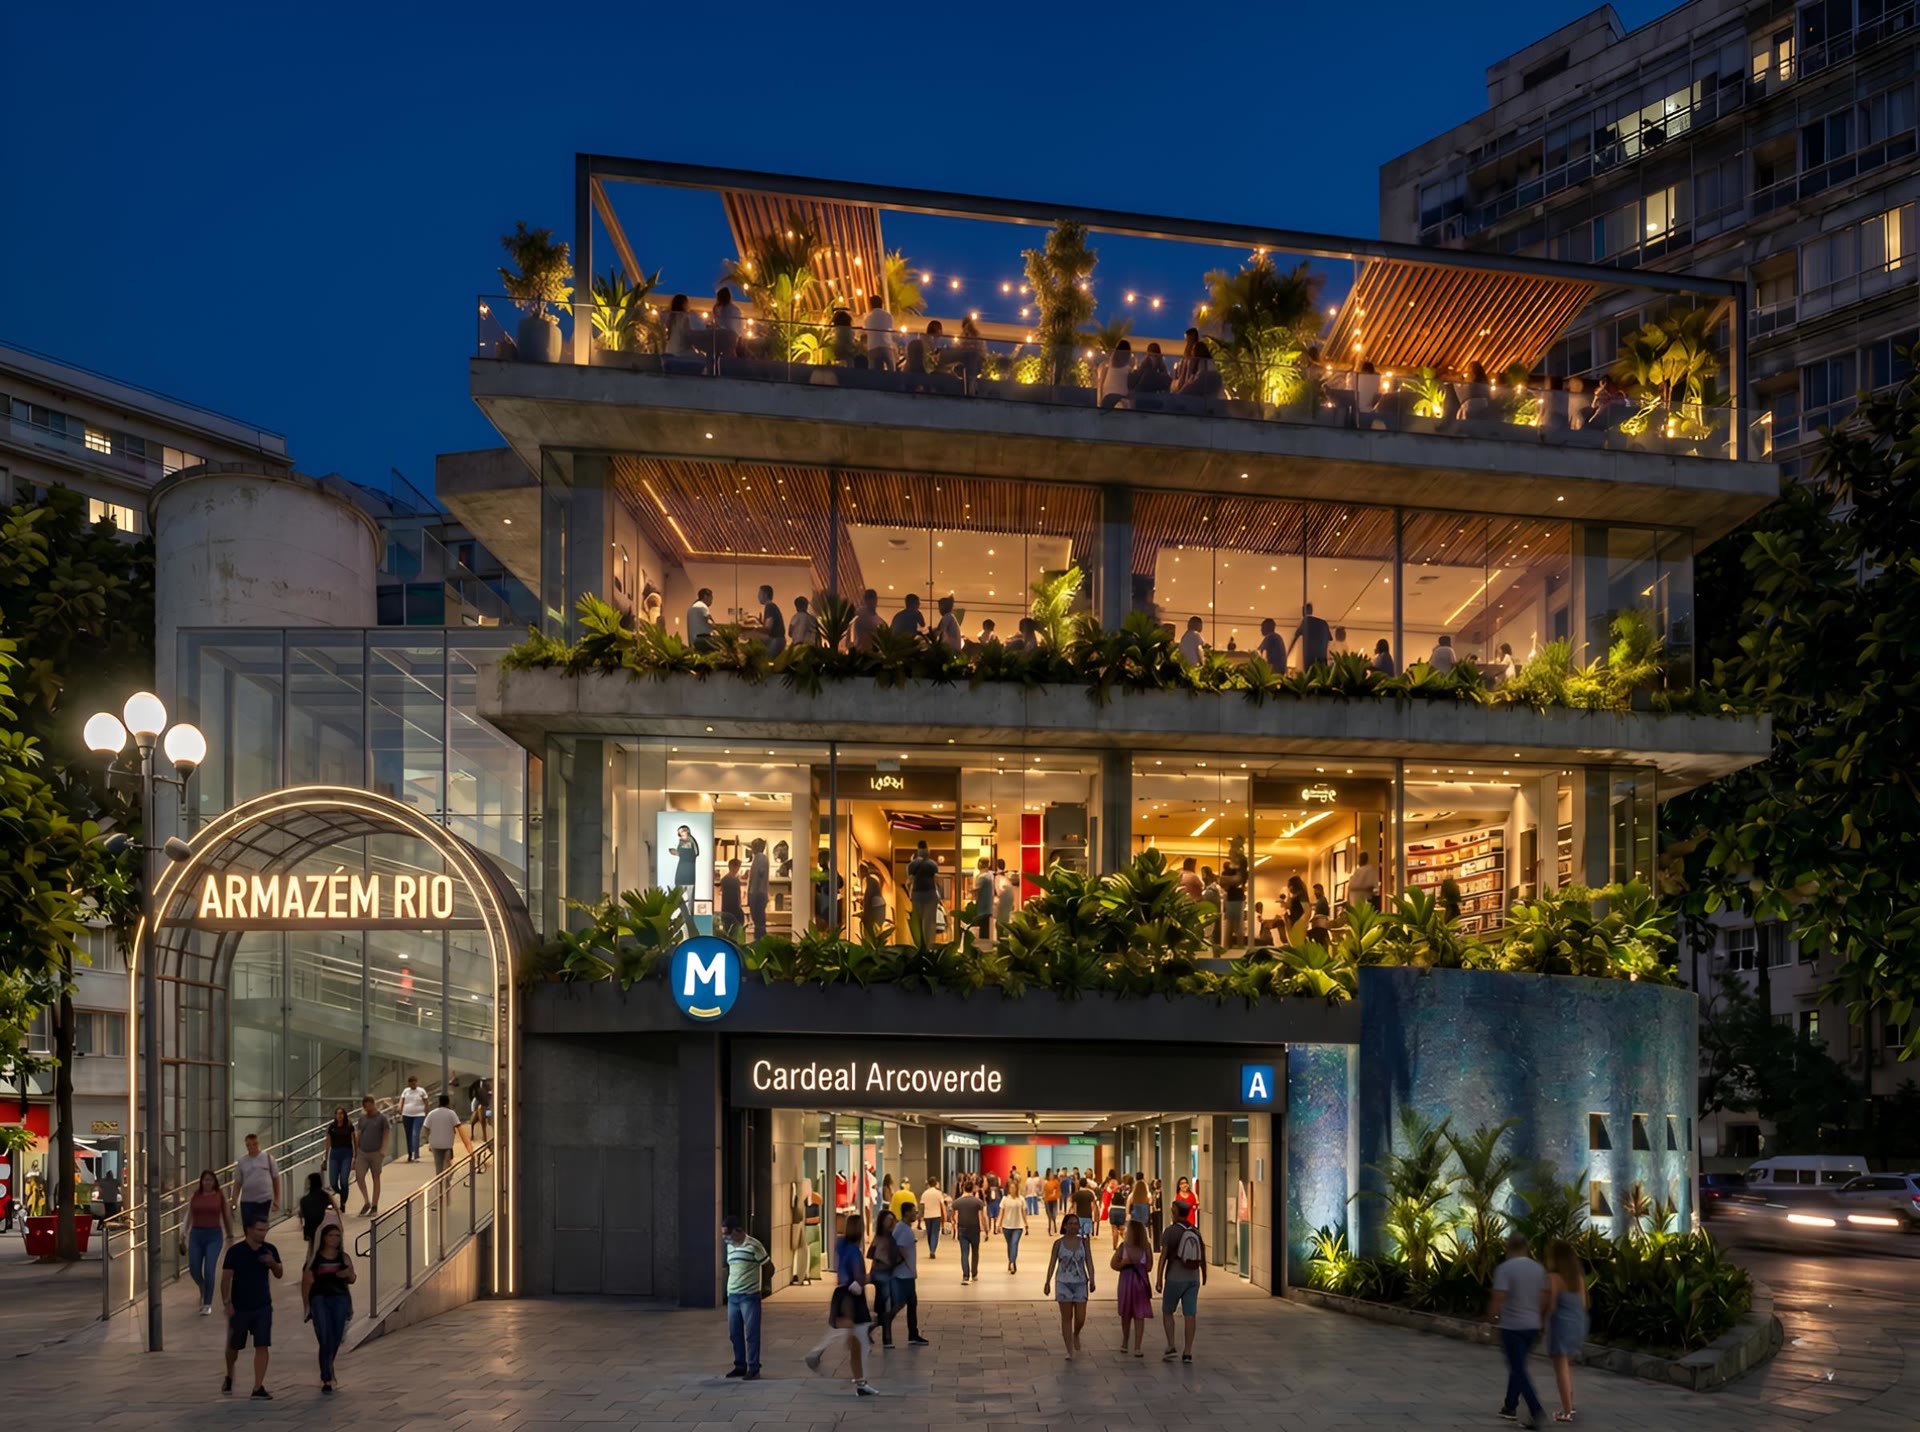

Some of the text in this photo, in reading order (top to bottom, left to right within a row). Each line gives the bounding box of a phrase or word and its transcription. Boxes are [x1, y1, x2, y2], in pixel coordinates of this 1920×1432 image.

[199, 866, 453, 918] ARMAZÉM RIO
[683, 951, 727, 996] M
[753, 1060, 1002, 1093] Cardeal Arcoverde
[1248, 1071, 1268, 1099] A
